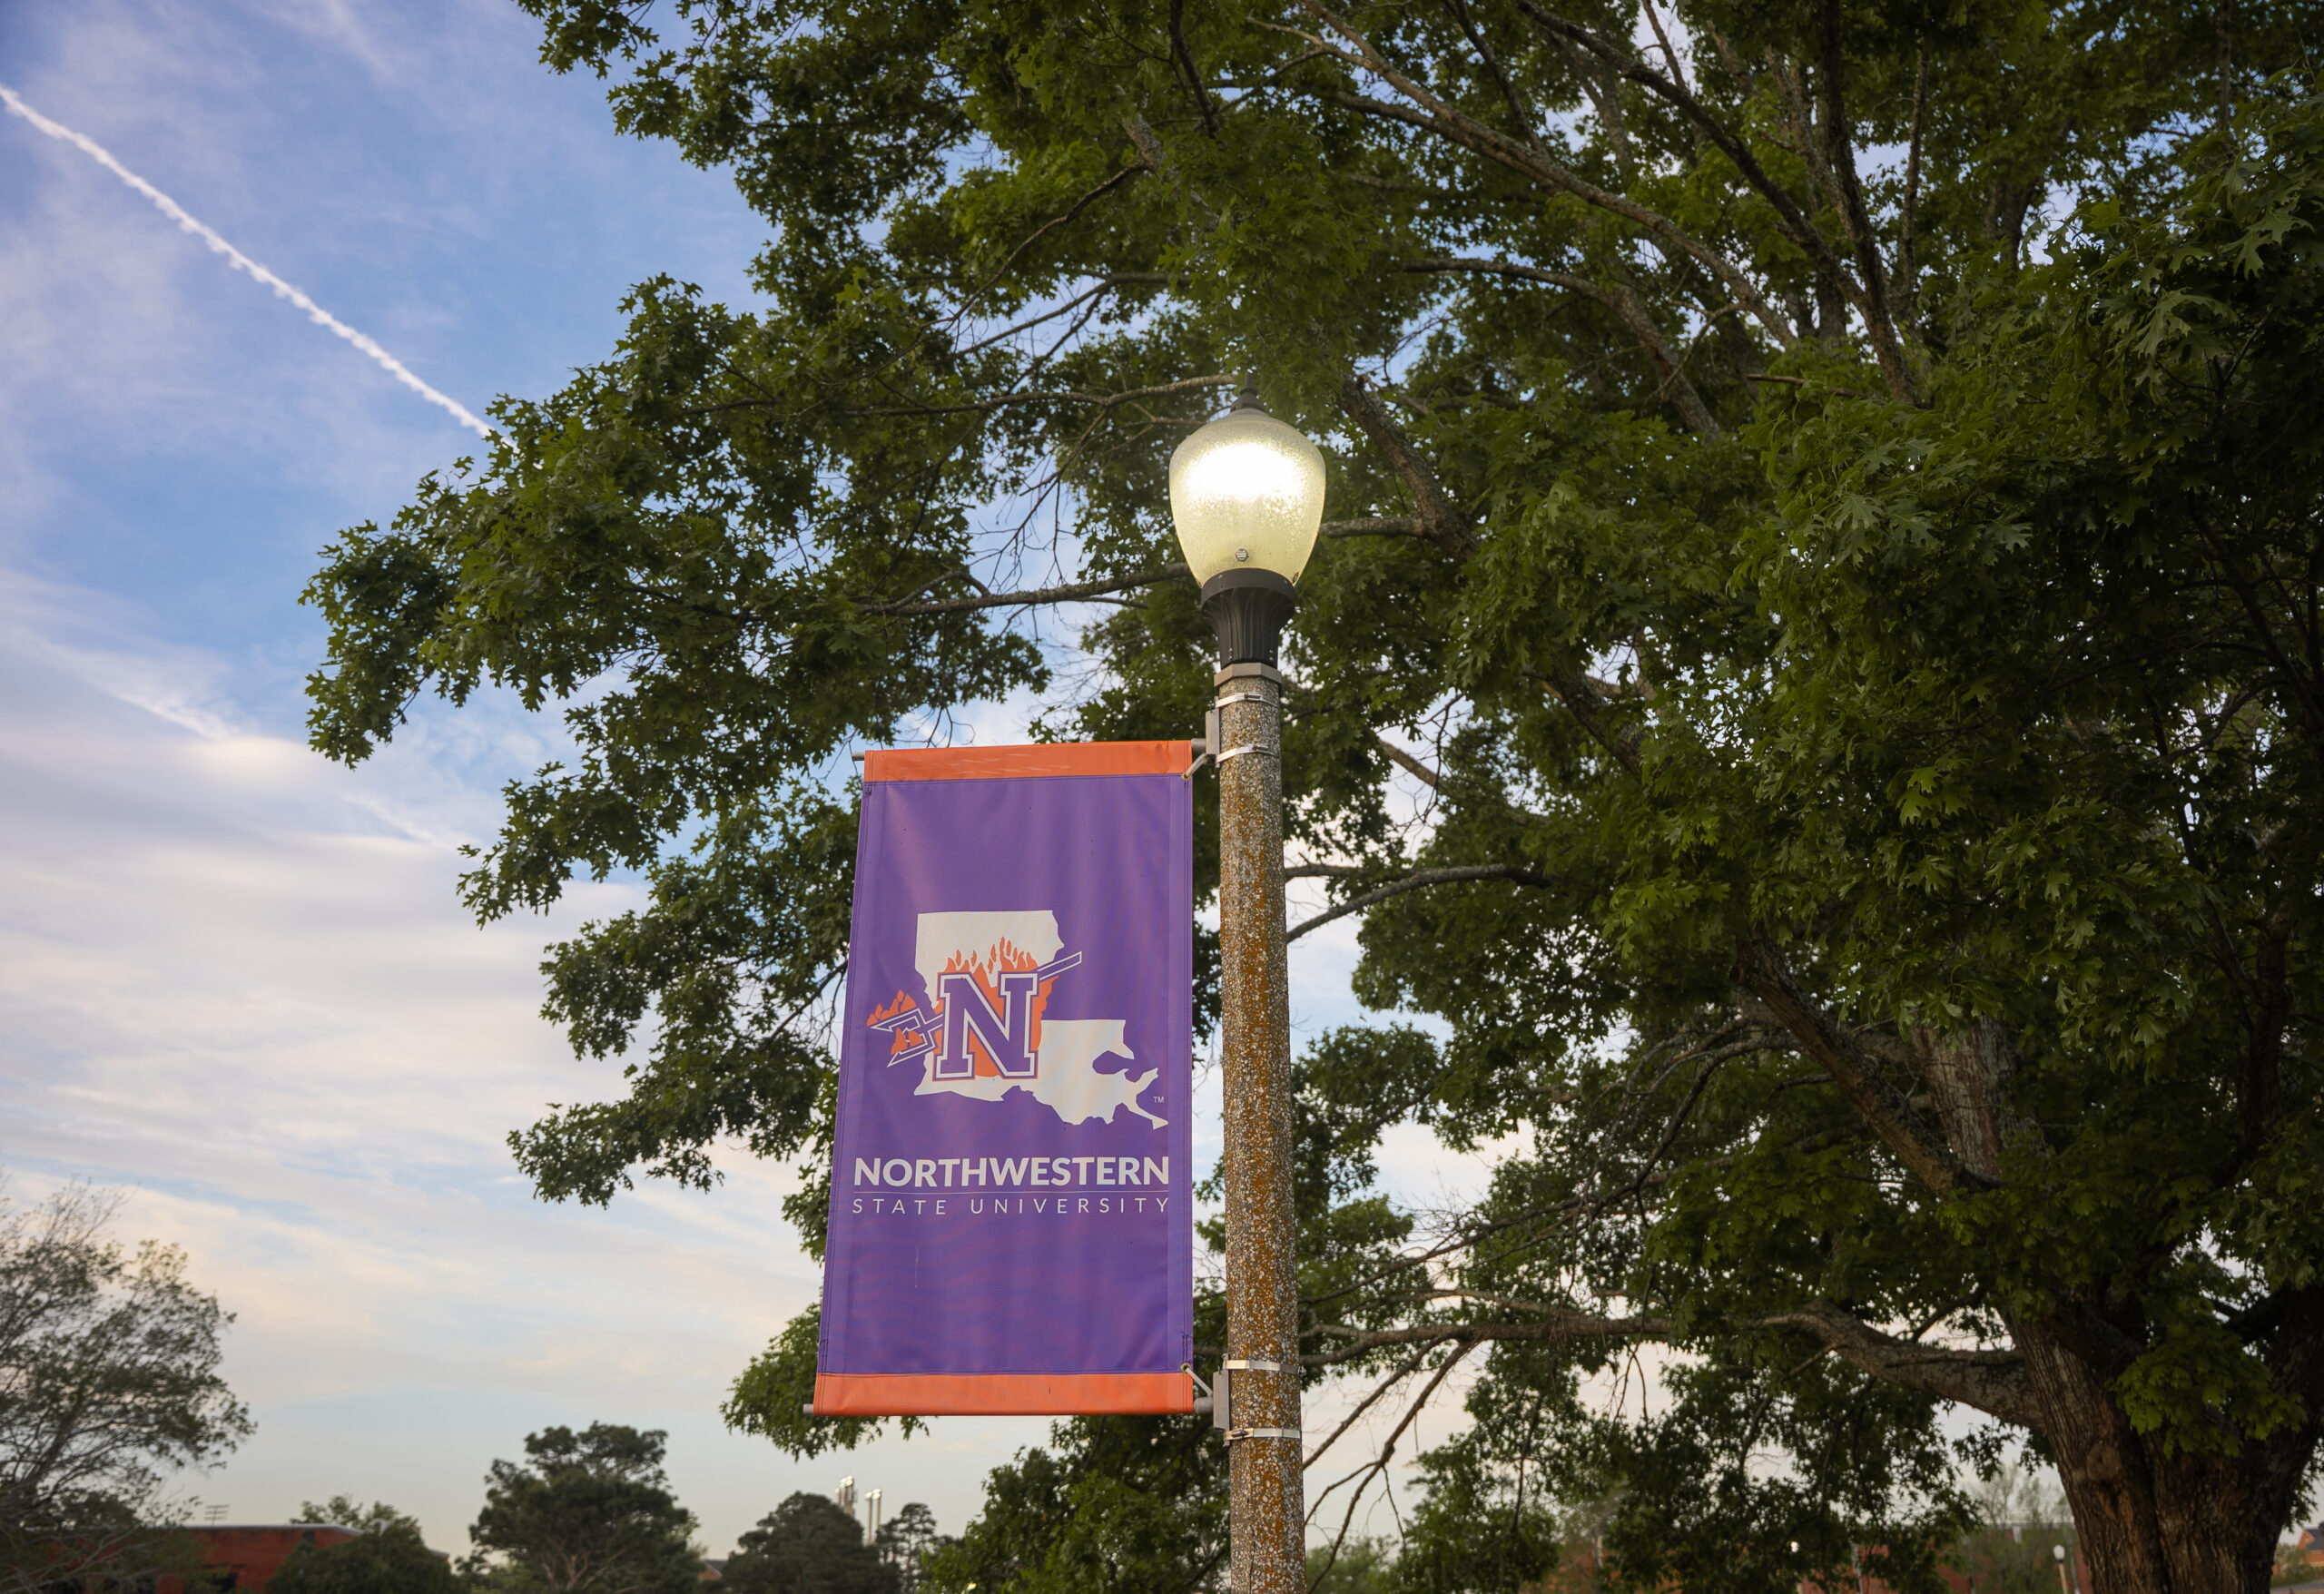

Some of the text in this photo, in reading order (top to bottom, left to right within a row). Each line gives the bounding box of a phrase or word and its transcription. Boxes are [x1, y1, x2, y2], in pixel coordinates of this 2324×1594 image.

[932, 970, 1039, 1082] N
[853, 1156, 1169, 1187] NORTHWESTERN
[852, 1197, 1169, 1215] STATE UNIVERSITY
